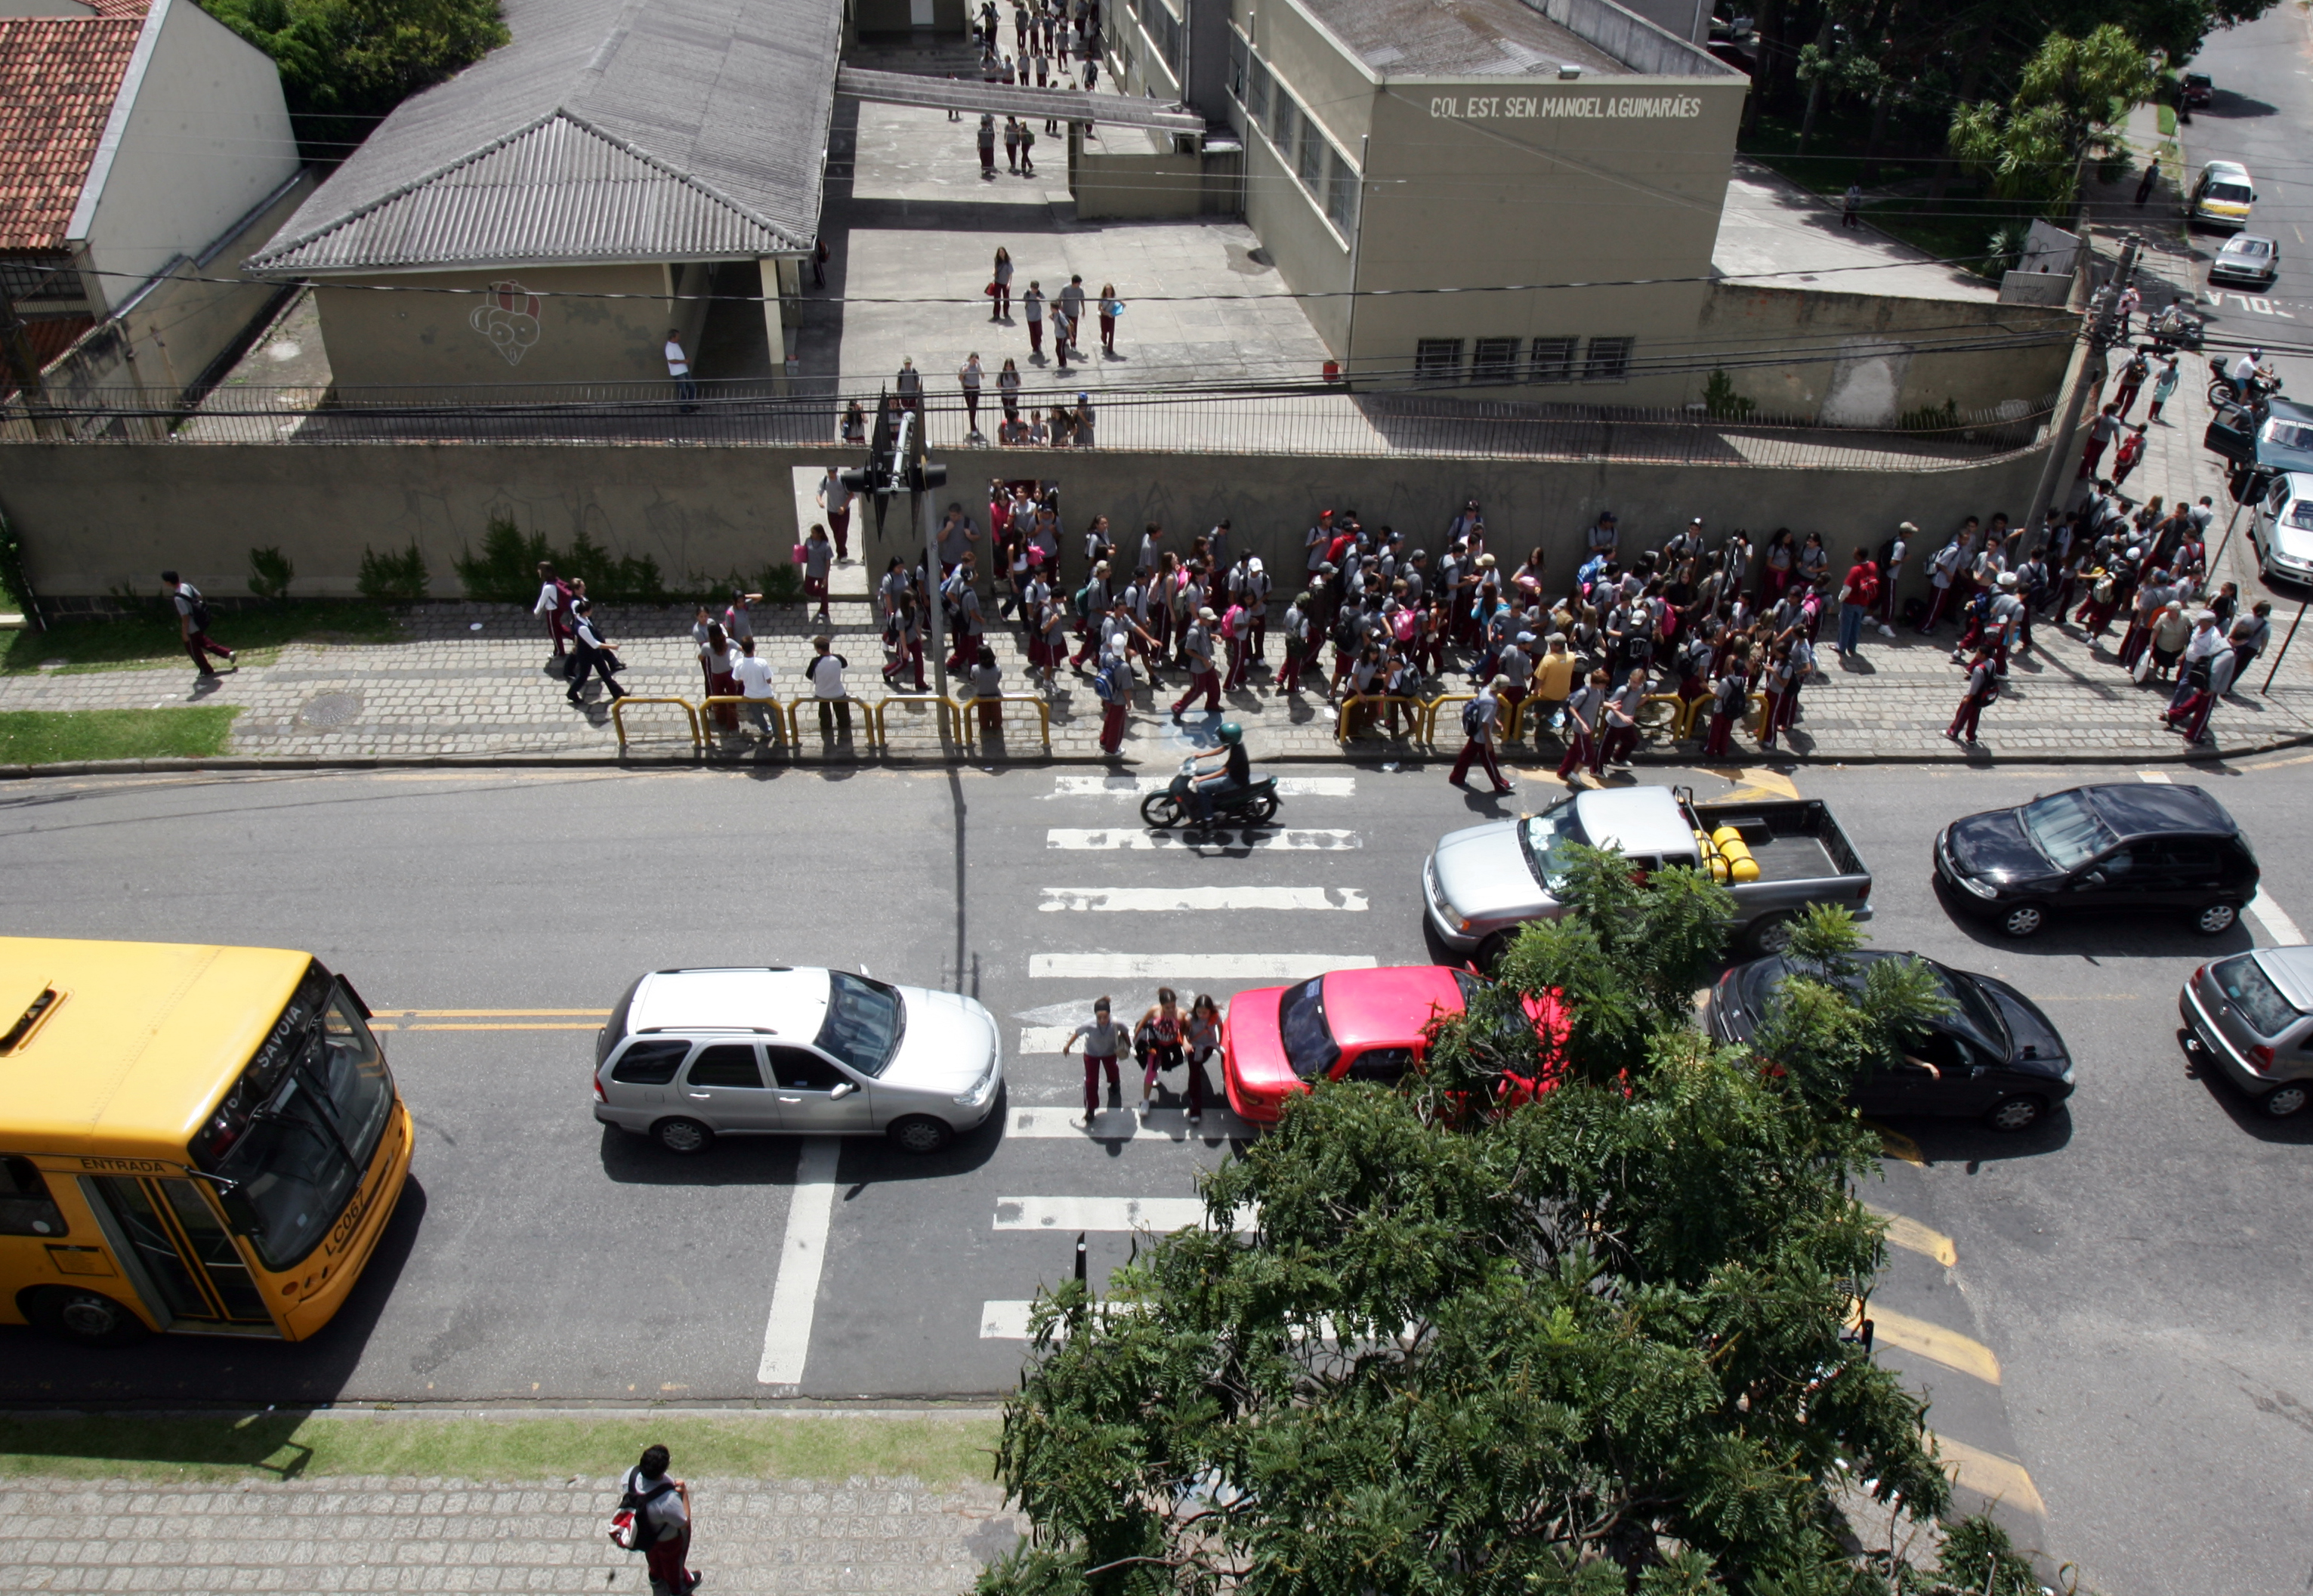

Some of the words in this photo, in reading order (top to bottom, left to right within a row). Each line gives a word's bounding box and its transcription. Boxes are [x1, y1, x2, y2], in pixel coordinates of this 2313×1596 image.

[1431, 97, 1464, 119] COL.
[1467, 97, 1499, 119] EST.
[1505, 97, 1539, 119] SEN.
[1542, 97, 1604, 119] MANOEL
[80, 1159, 166, 1173] ENTRADA
[325, 1188, 364, 1257] LC067
